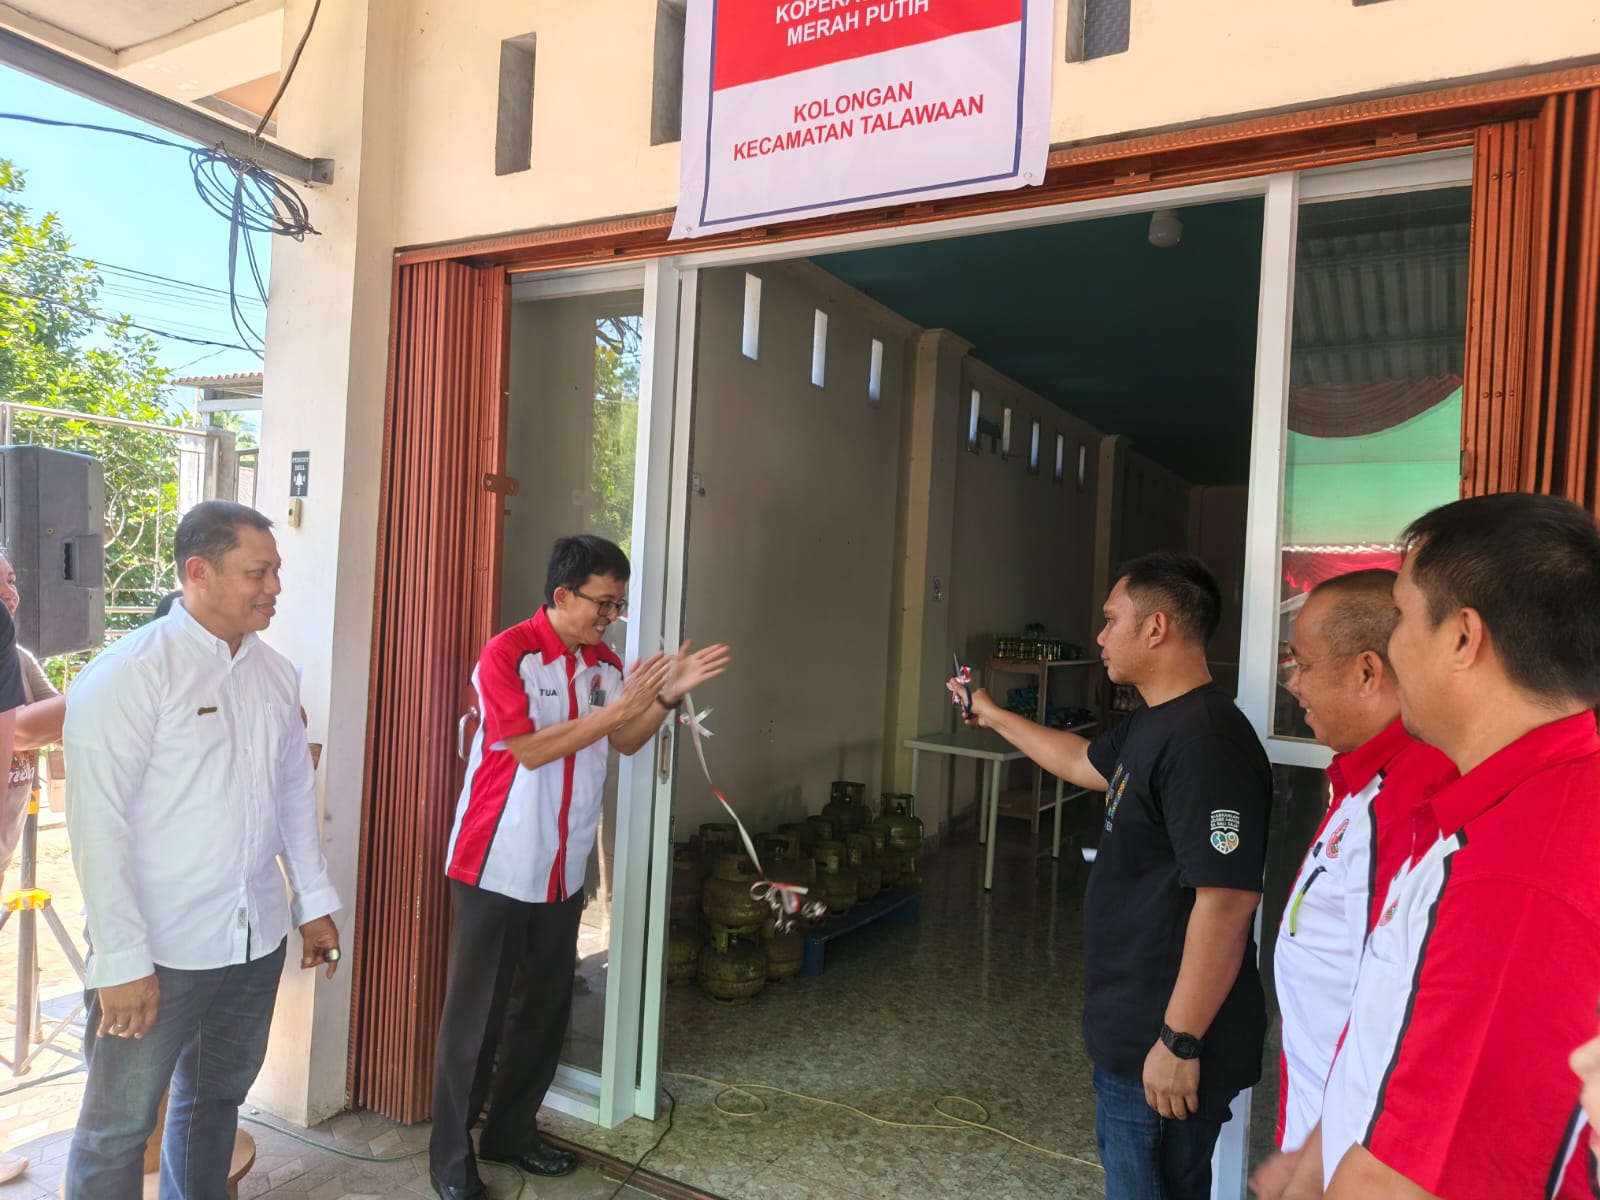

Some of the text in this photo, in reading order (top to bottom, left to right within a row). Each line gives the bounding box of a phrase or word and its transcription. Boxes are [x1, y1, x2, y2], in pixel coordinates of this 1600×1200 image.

[775, 0, 868, 24] KOPER
[787, 0, 930, 47] MERAH PUTIH
[793, 80, 913, 124] KOLONGAN
[733, 94, 984, 161] KECAMATAN TALAWAAN
